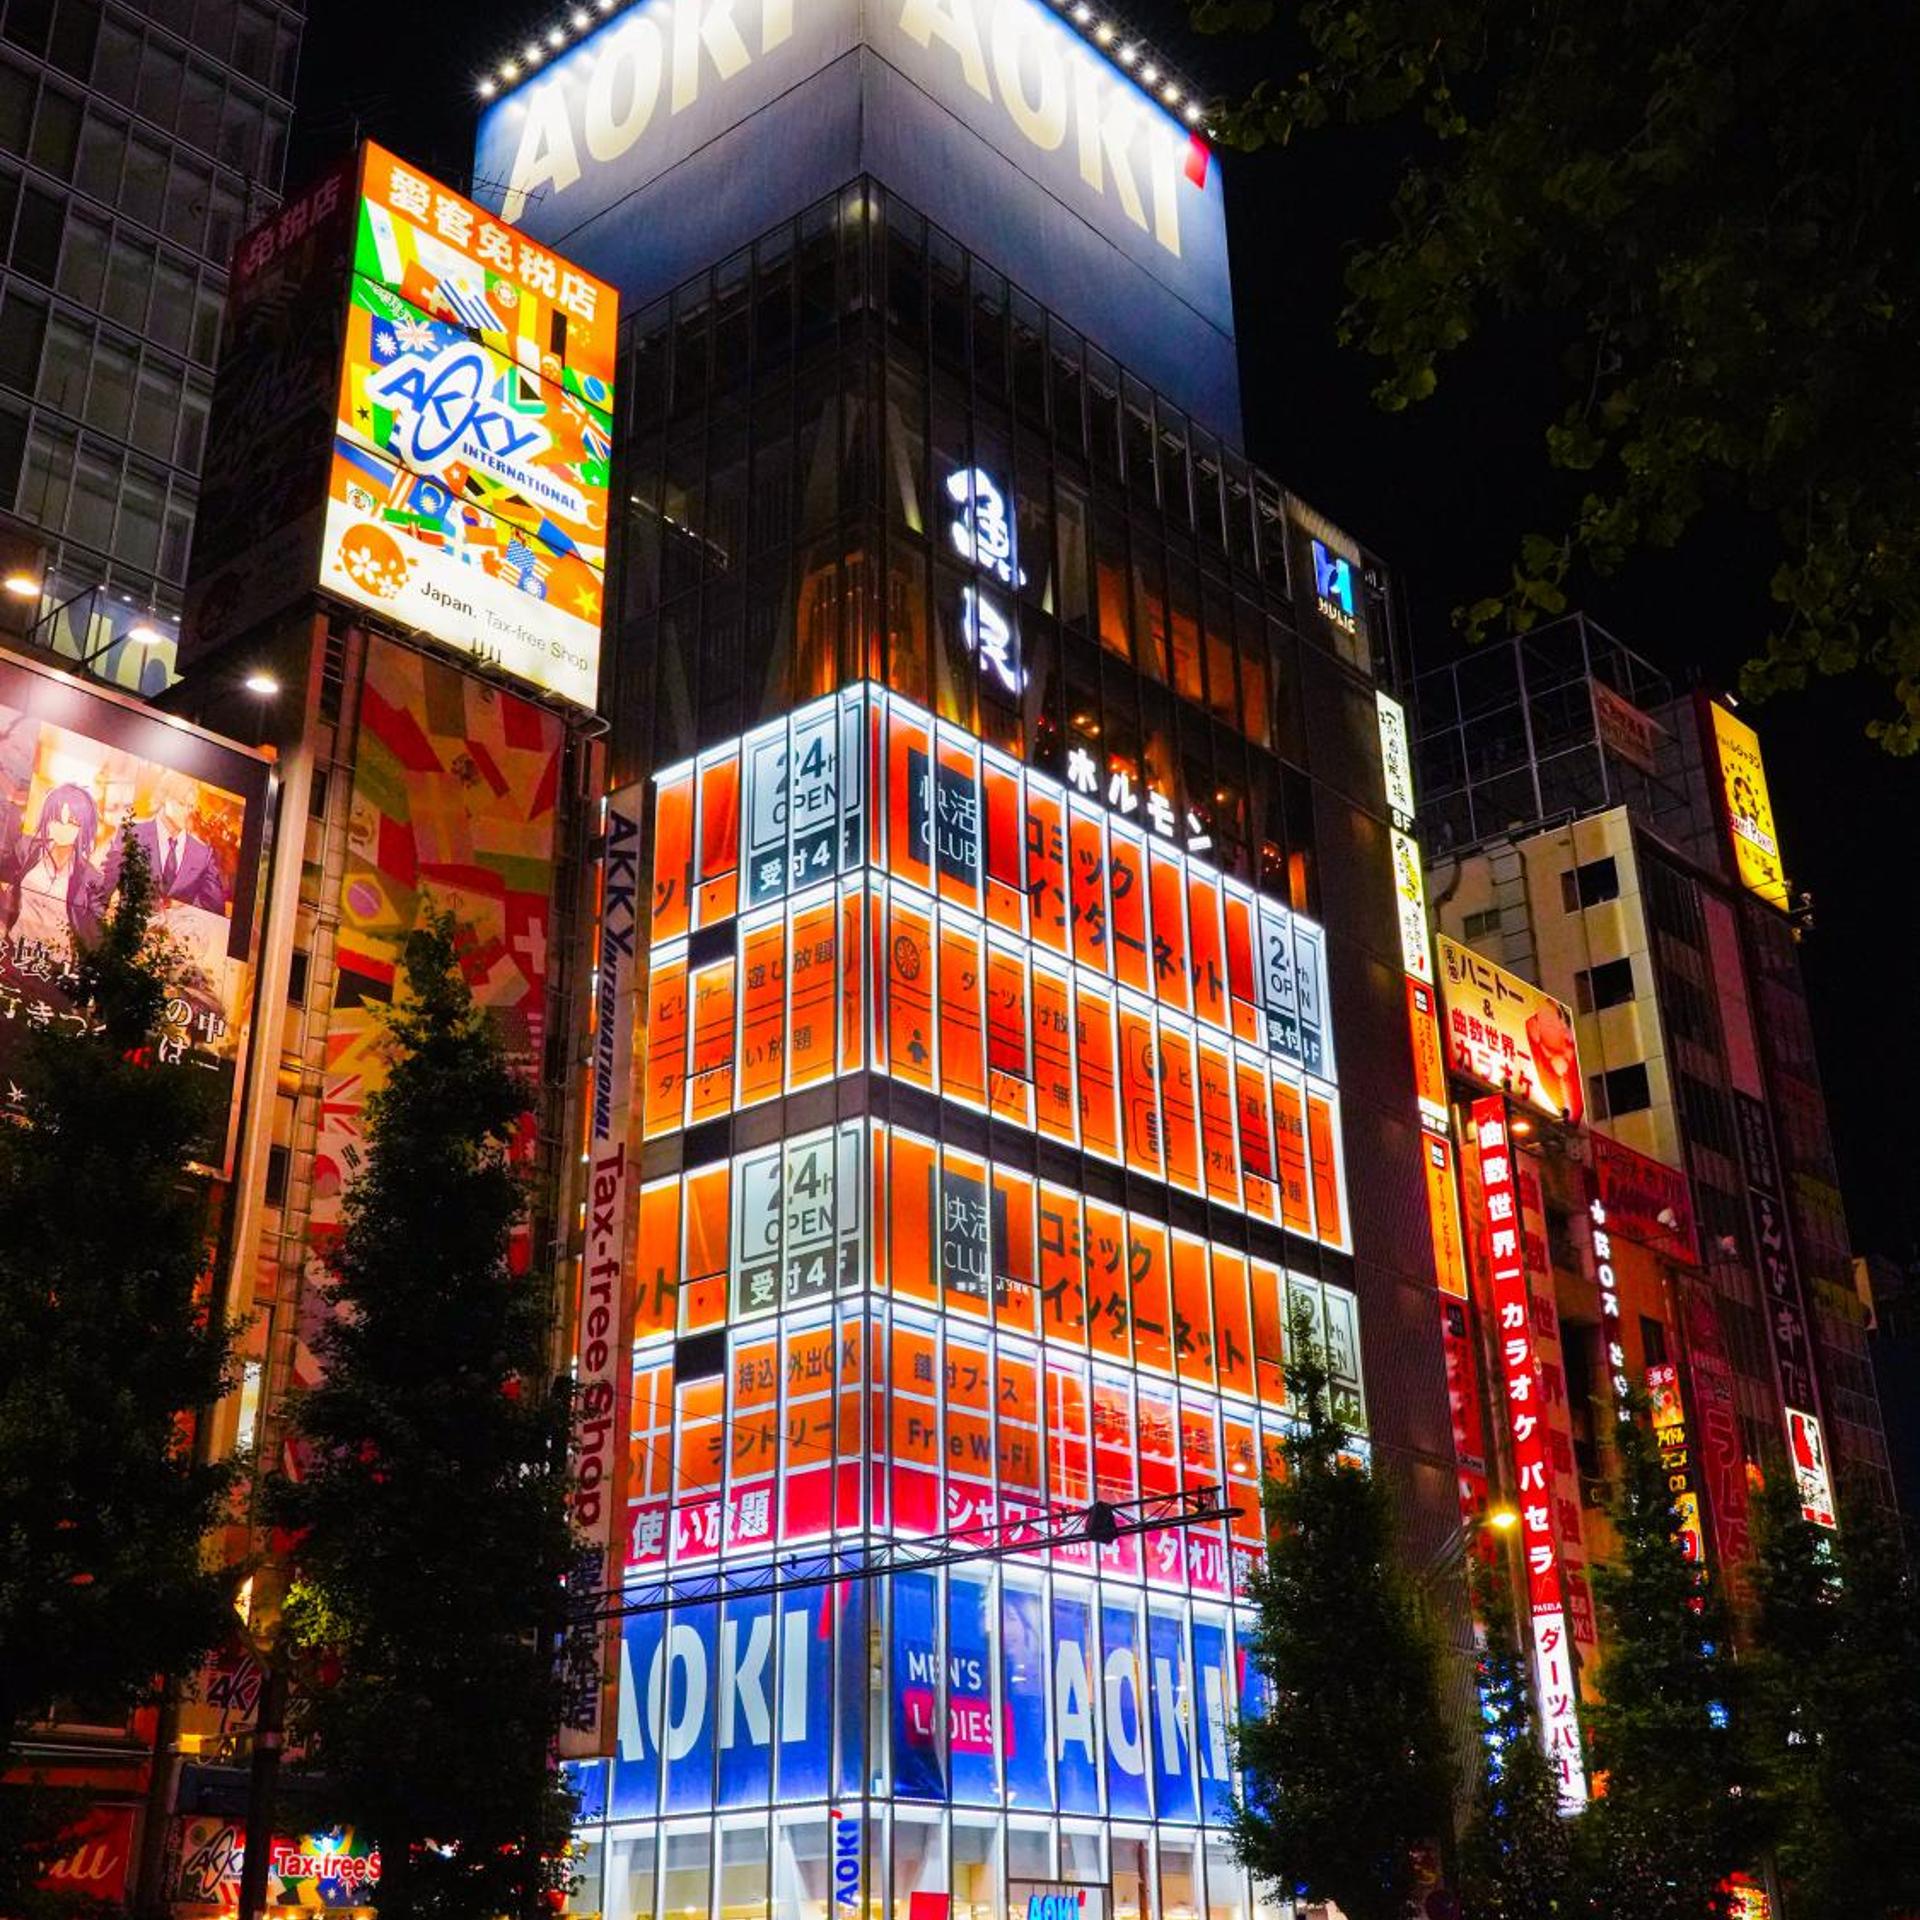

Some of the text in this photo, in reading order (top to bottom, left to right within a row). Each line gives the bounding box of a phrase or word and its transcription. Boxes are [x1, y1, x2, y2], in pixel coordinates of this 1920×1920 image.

[378, 355, 540, 462] AKKY
[462, 440, 578, 512] INTERNATIONAL
[421, 580, 589, 672] Japan. Tax-free Shop
[1318, 597, 1356, 634] HULIC
[1067, 748, 1212, 851] ホルモン
[605, 808, 639, 957] AKKY
[1027, 814, 1134, 899] コミック
[1270, 973, 1312, 1011] OPN
[1461, 954, 1525, 1005] ハニトー
[595, 938, 618, 1140] INTERNATIONAL
[1451, 1007, 1532, 1062] 曲数世界一
[586, 1140, 626, 1368] Tax-free
[764, 1204, 833, 1246] OPEN
[1040, 1210, 1151, 1284] コミック
[907, 1417, 964, 1457] Fre
[631, 1488, 771, 1558] 使い放題
[912, 1701, 995, 1745] LDIES
[276, 1847, 371, 1881] Tax-free
[835, 1819, 861, 1907] AOKI
